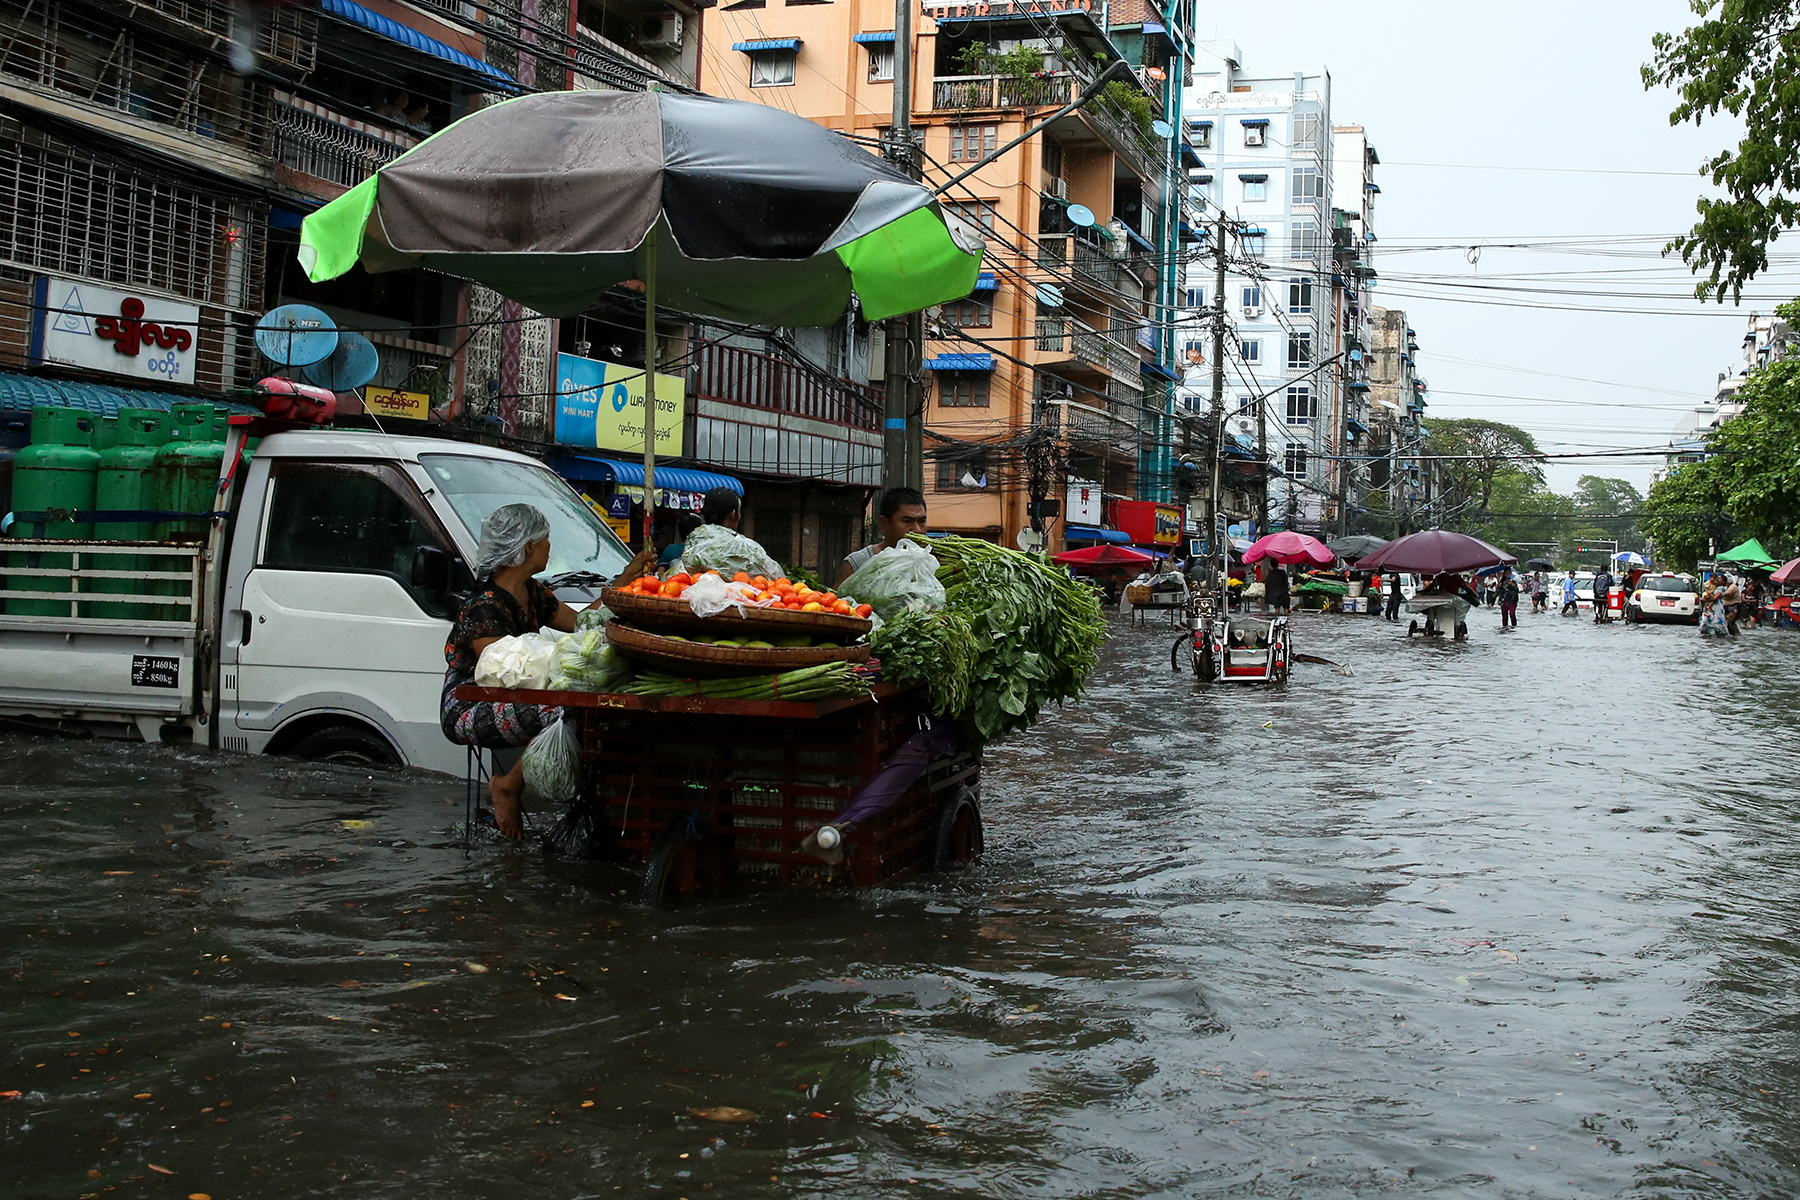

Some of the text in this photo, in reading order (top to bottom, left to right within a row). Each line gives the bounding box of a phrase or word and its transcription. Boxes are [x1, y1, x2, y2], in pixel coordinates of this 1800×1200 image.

[148, 351, 180, 379] စတိုး
[574, 383, 597, 403] YES
[563, 406, 594, 418] MINI MART
[151, 673, 172, 685] 850kg
